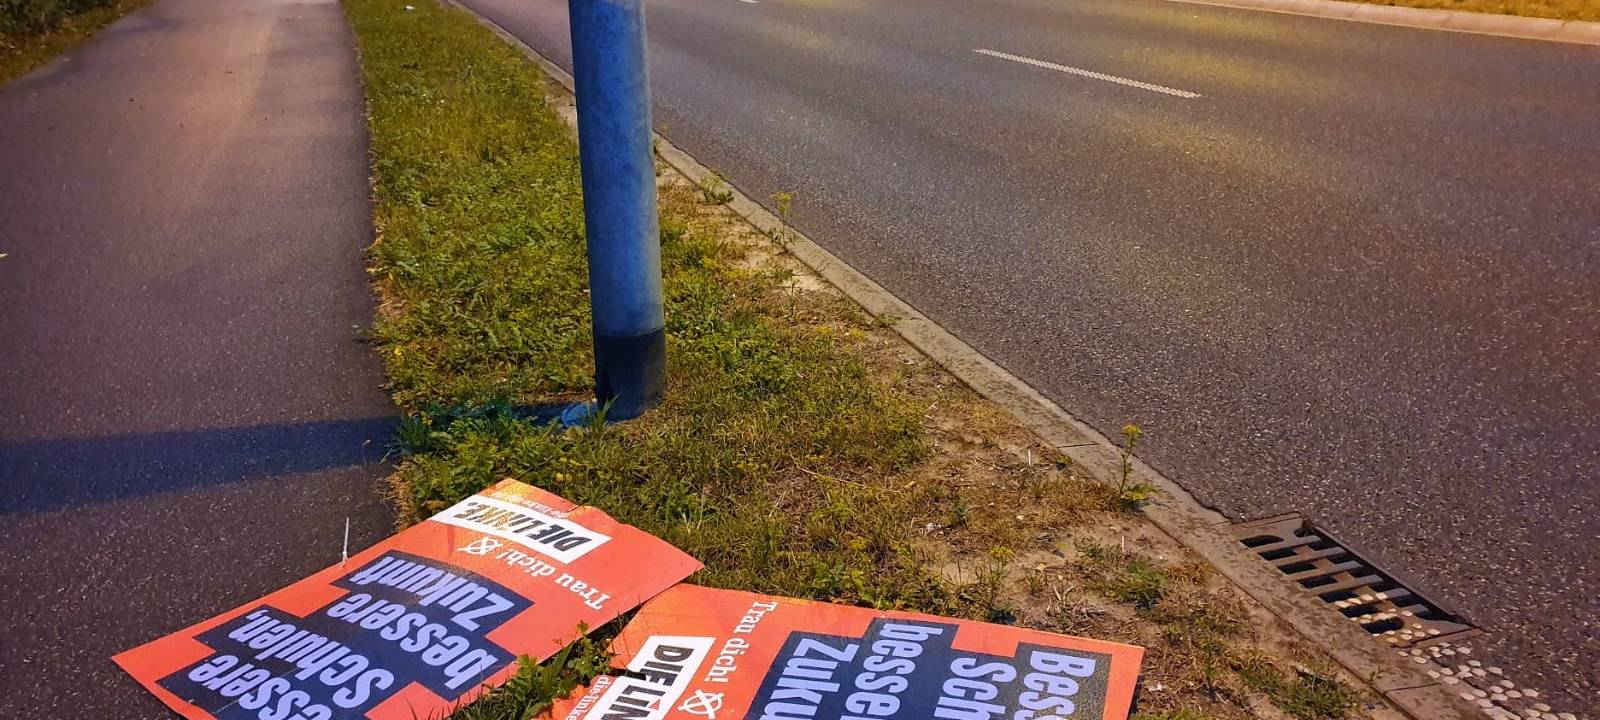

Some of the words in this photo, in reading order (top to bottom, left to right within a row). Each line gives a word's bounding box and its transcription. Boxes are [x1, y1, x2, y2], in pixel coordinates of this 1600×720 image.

[496, 549, 555, 577] dich!
[349, 556, 514, 632] Zukunft
[556, 573, 610, 611] Trau
[733, 601, 777, 634] Trau
[228, 609, 394, 708] Schulen,
[327, 593, 498, 690] bessere
[703, 638, 748, 683] dich!
